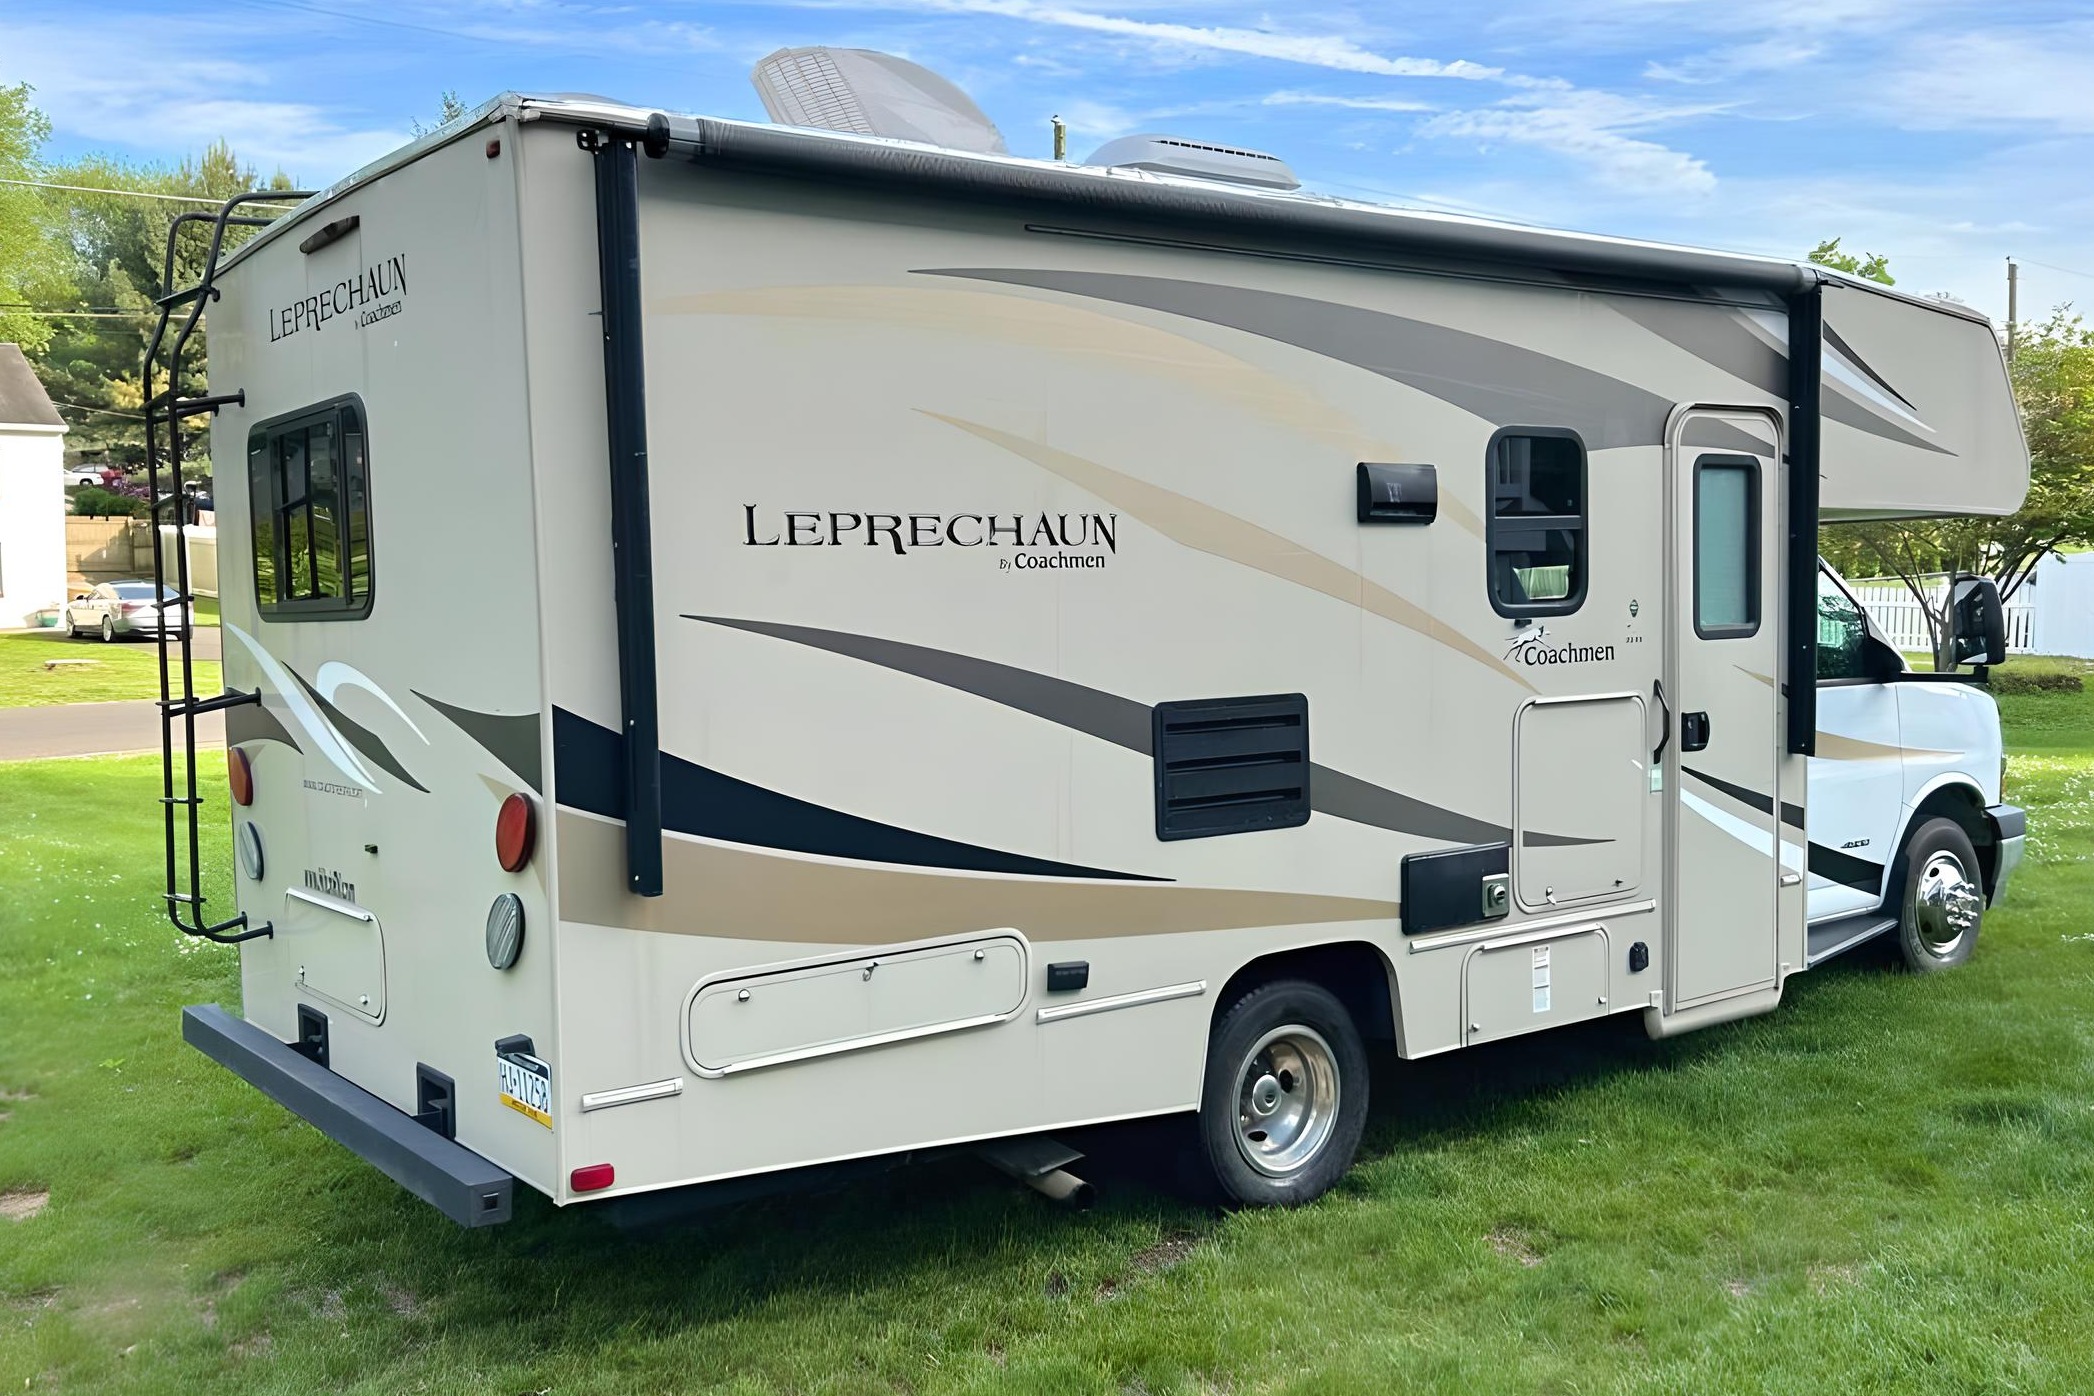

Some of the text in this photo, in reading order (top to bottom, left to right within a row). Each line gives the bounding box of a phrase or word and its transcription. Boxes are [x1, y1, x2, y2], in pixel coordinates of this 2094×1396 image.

[269, 253, 408, 343] LEPRECHAUN
[741, 502, 1117, 555] LEPRECHAUN
[1014, 551, 1105, 570] Coachmen
[1524, 642, 1615, 666] Coachmen
